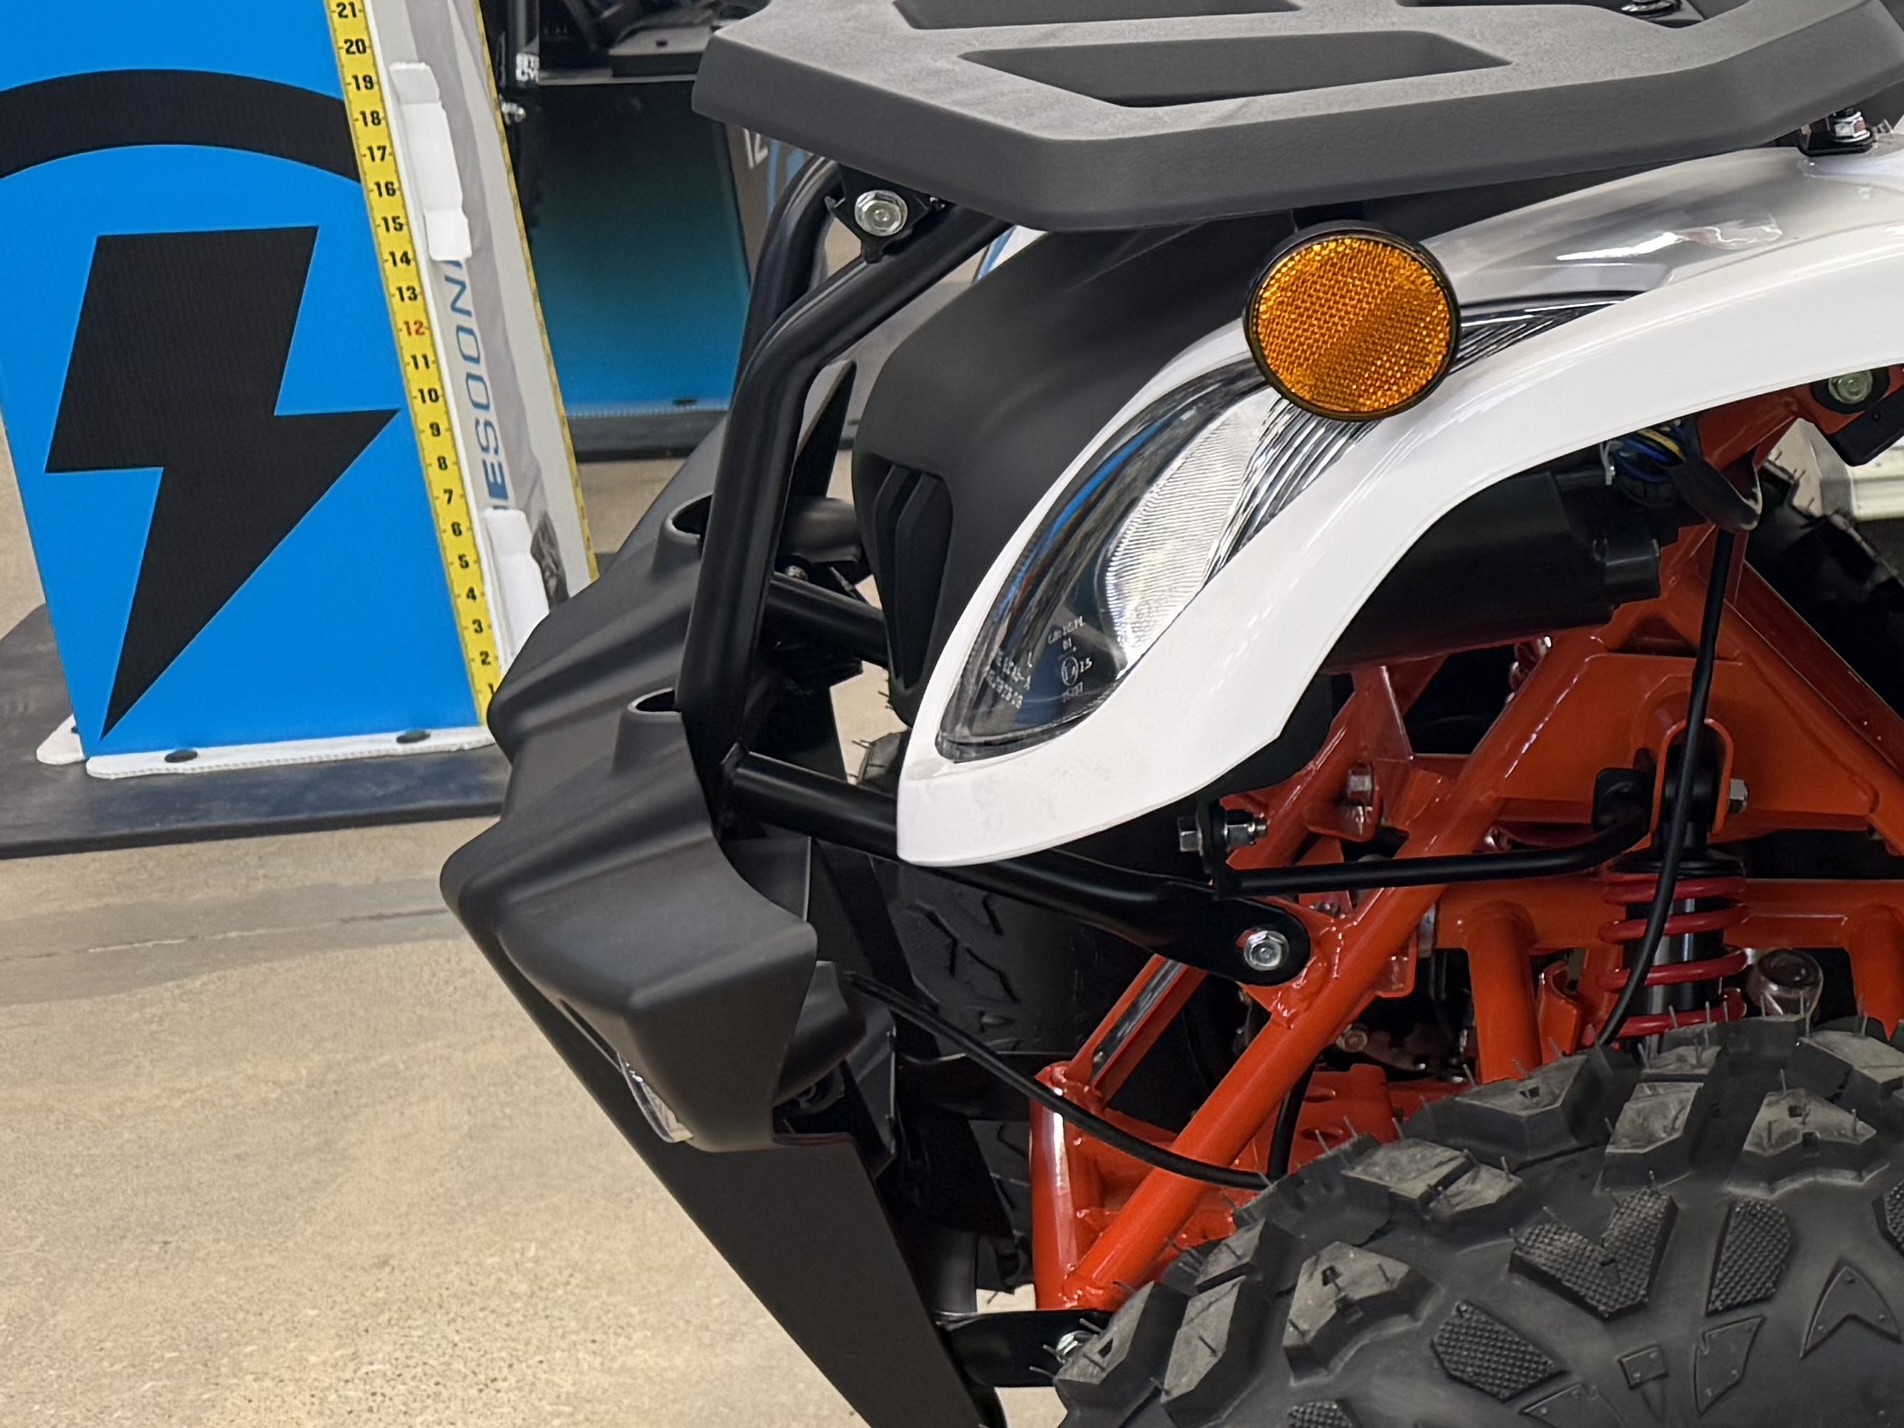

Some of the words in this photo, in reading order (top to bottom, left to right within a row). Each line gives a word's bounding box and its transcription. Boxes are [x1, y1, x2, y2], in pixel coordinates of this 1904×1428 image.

[336, 2, 358, 19] 21
[343, 39, 367, 56] 20
[352, 74, 374, 92] 19
[359, 110, 382, 127] 18
[366, 146, 388, 163] 17
[374, 181, 396, 199] 16
[381, 216, 404, 234] 15
[388, 250, 412, 268] 14
[395, 285, 419, 302] 13
[403, 320, 425, 337] 12
[410, 354, 429, 371] 11
[418, 387, 440, 405] 10
[430, 421, 440, 438] 9
[437, 455, 447, 472] 8
[443, 489, 453, 505] 7
[451, 521, 461, 538] 6
[458, 553, 468, 570] 5
[465, 586, 477, 603] 4
[472, 619, 483, 635] 3
[479, 650, 490, 667] 2
